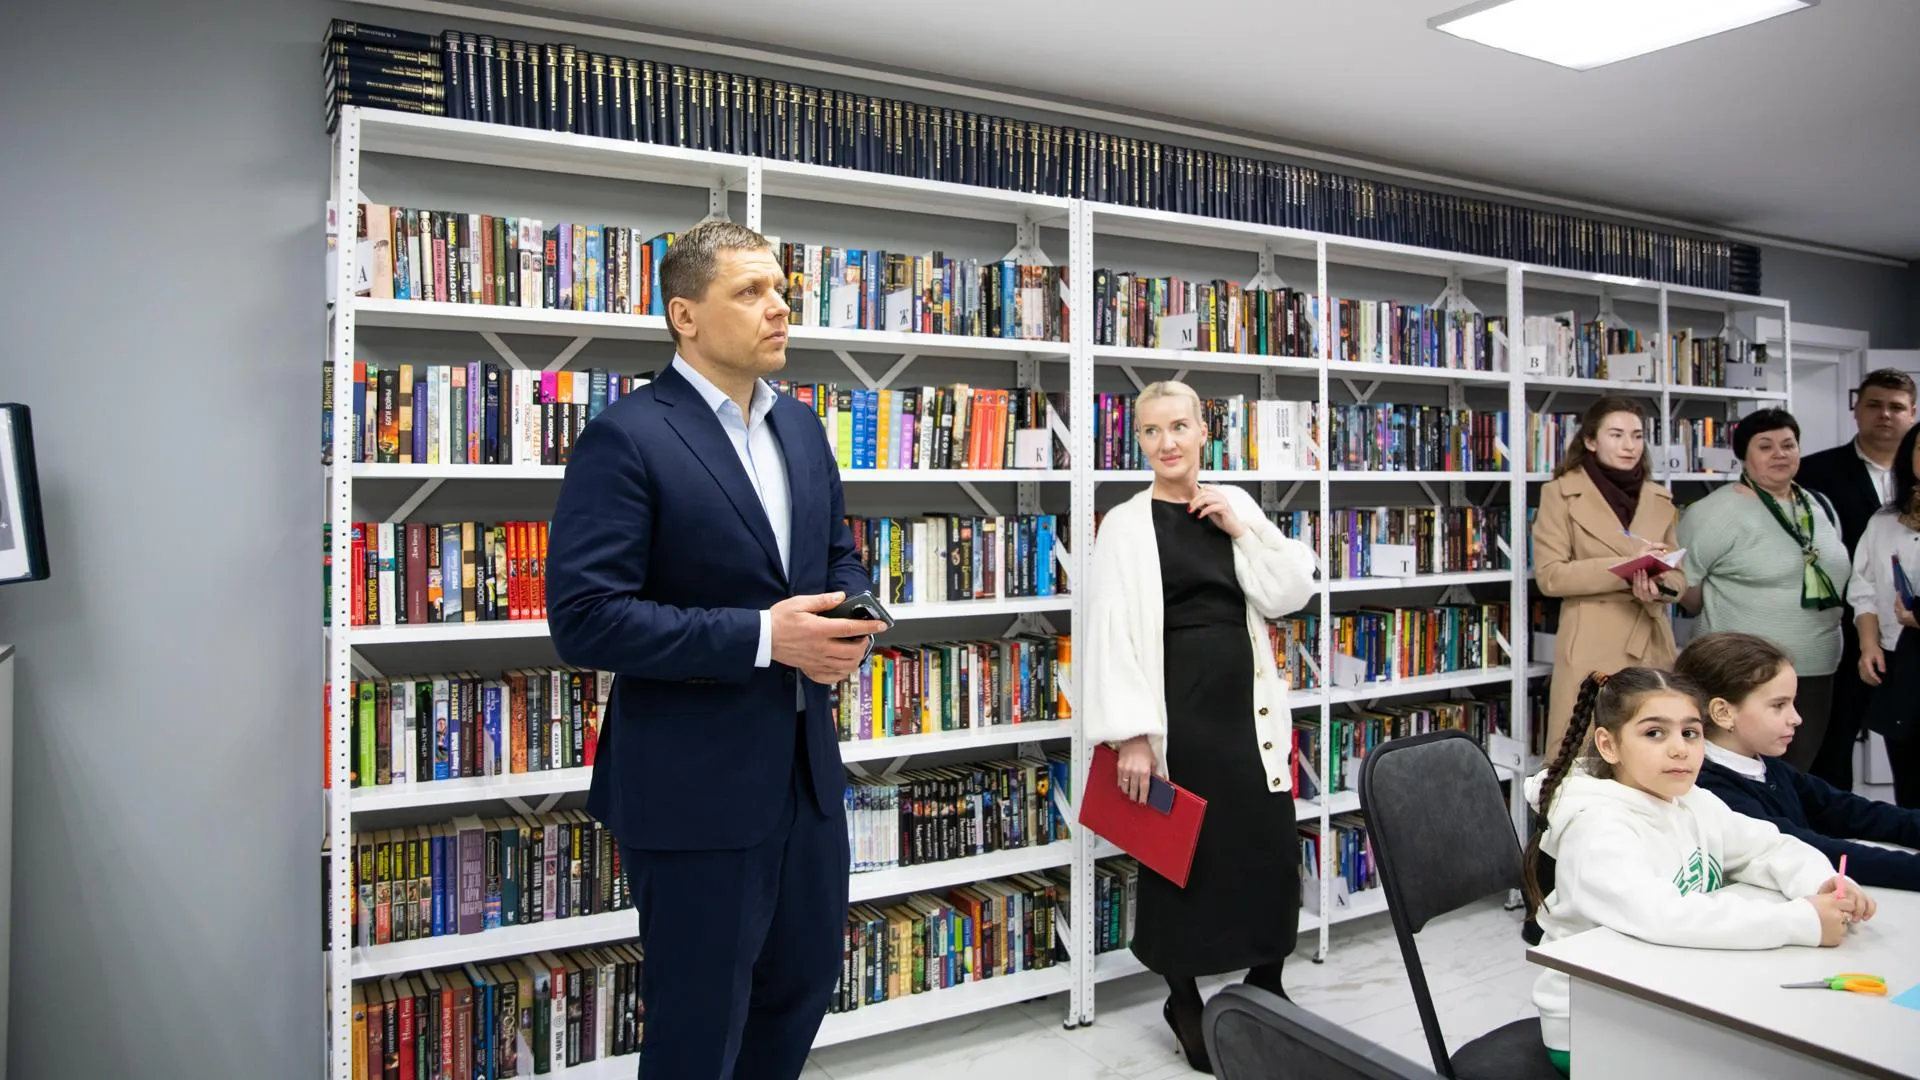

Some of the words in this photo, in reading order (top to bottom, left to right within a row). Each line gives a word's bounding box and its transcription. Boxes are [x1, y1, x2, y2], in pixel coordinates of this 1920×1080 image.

[358, 266, 368, 283] А
[448, 252, 457, 301] ОХОТНИЦА
[847, 304, 853, 319] Е
[900, 309, 908, 325] Ж
[1181, 328, 1193, 343] М
[1529, 356, 1539, 369] В
[1637, 363, 1646, 377] Г
[1753, 366, 1762, 377] Н
[1036, 448, 1043, 462] К
[1669, 458, 1680, 469] О
[1400, 560, 1410, 572] Т
[369, 579, 377, 611] БУШКОВ
[613, 878, 621, 907] ЦЕНА
